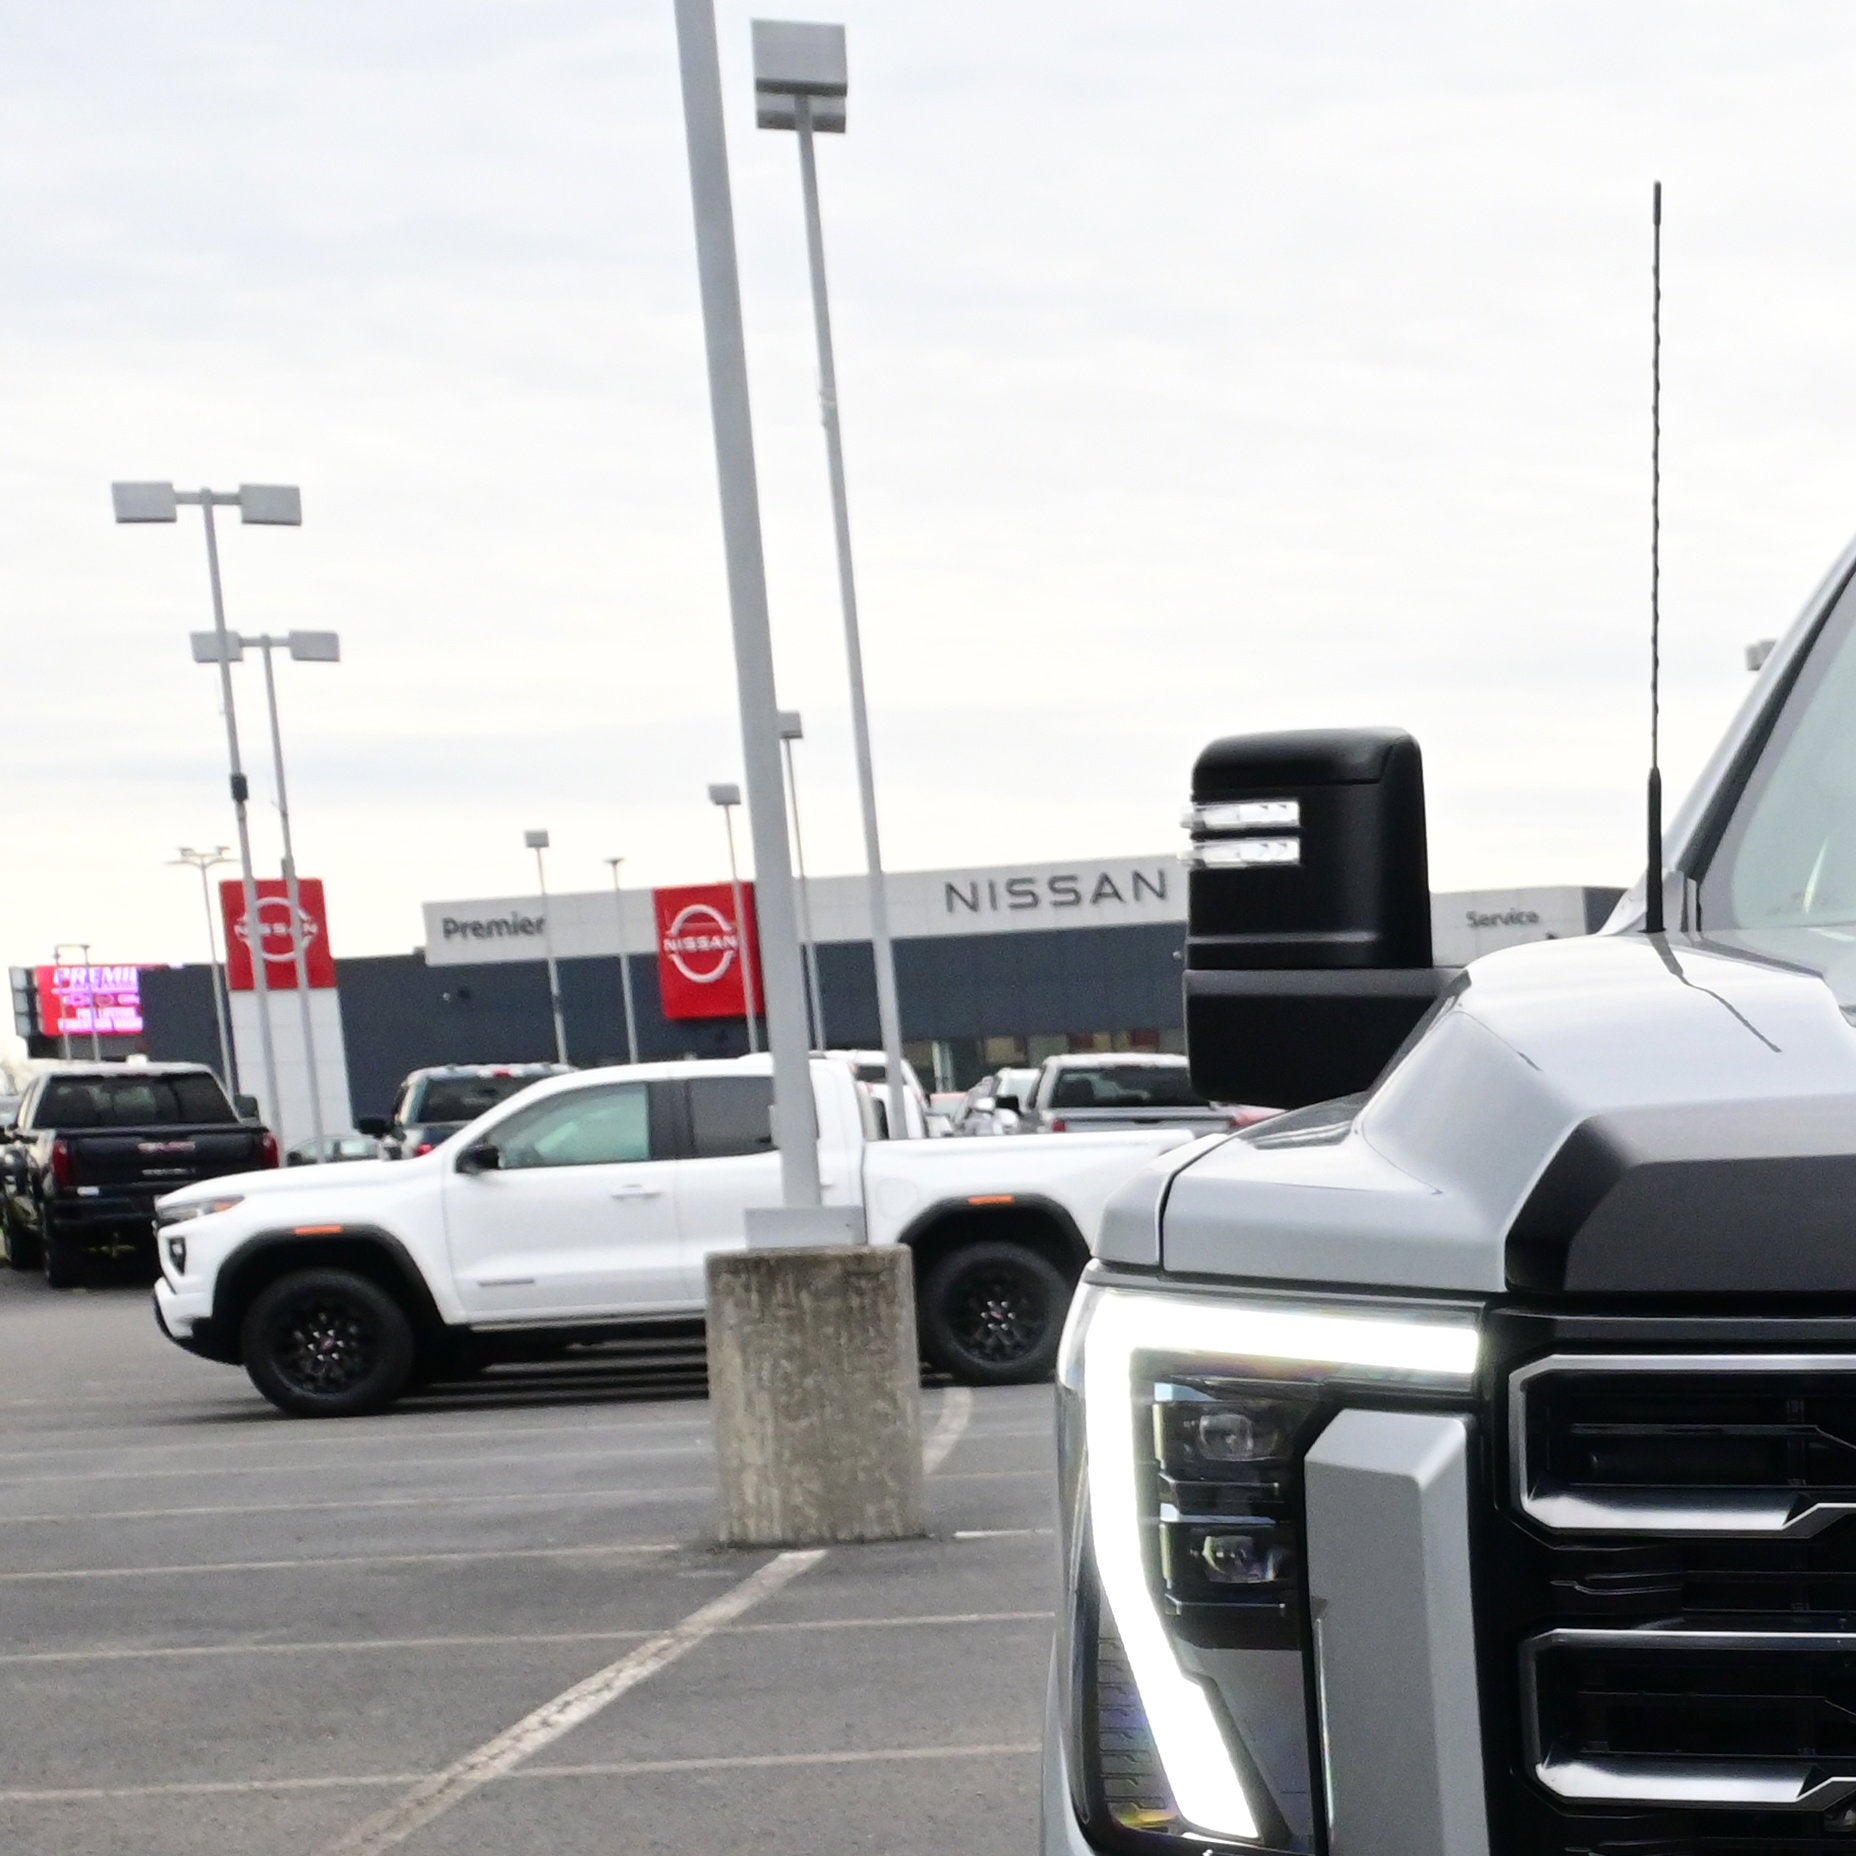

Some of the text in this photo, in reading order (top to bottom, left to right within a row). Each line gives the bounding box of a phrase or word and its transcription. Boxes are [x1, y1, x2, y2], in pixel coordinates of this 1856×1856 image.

[944, 868, 1168, 913] NISSAN
[442, 911, 545, 940] Premier
[1465, 907, 1540, 928] Service
[663, 934, 738, 952] NISSAN
